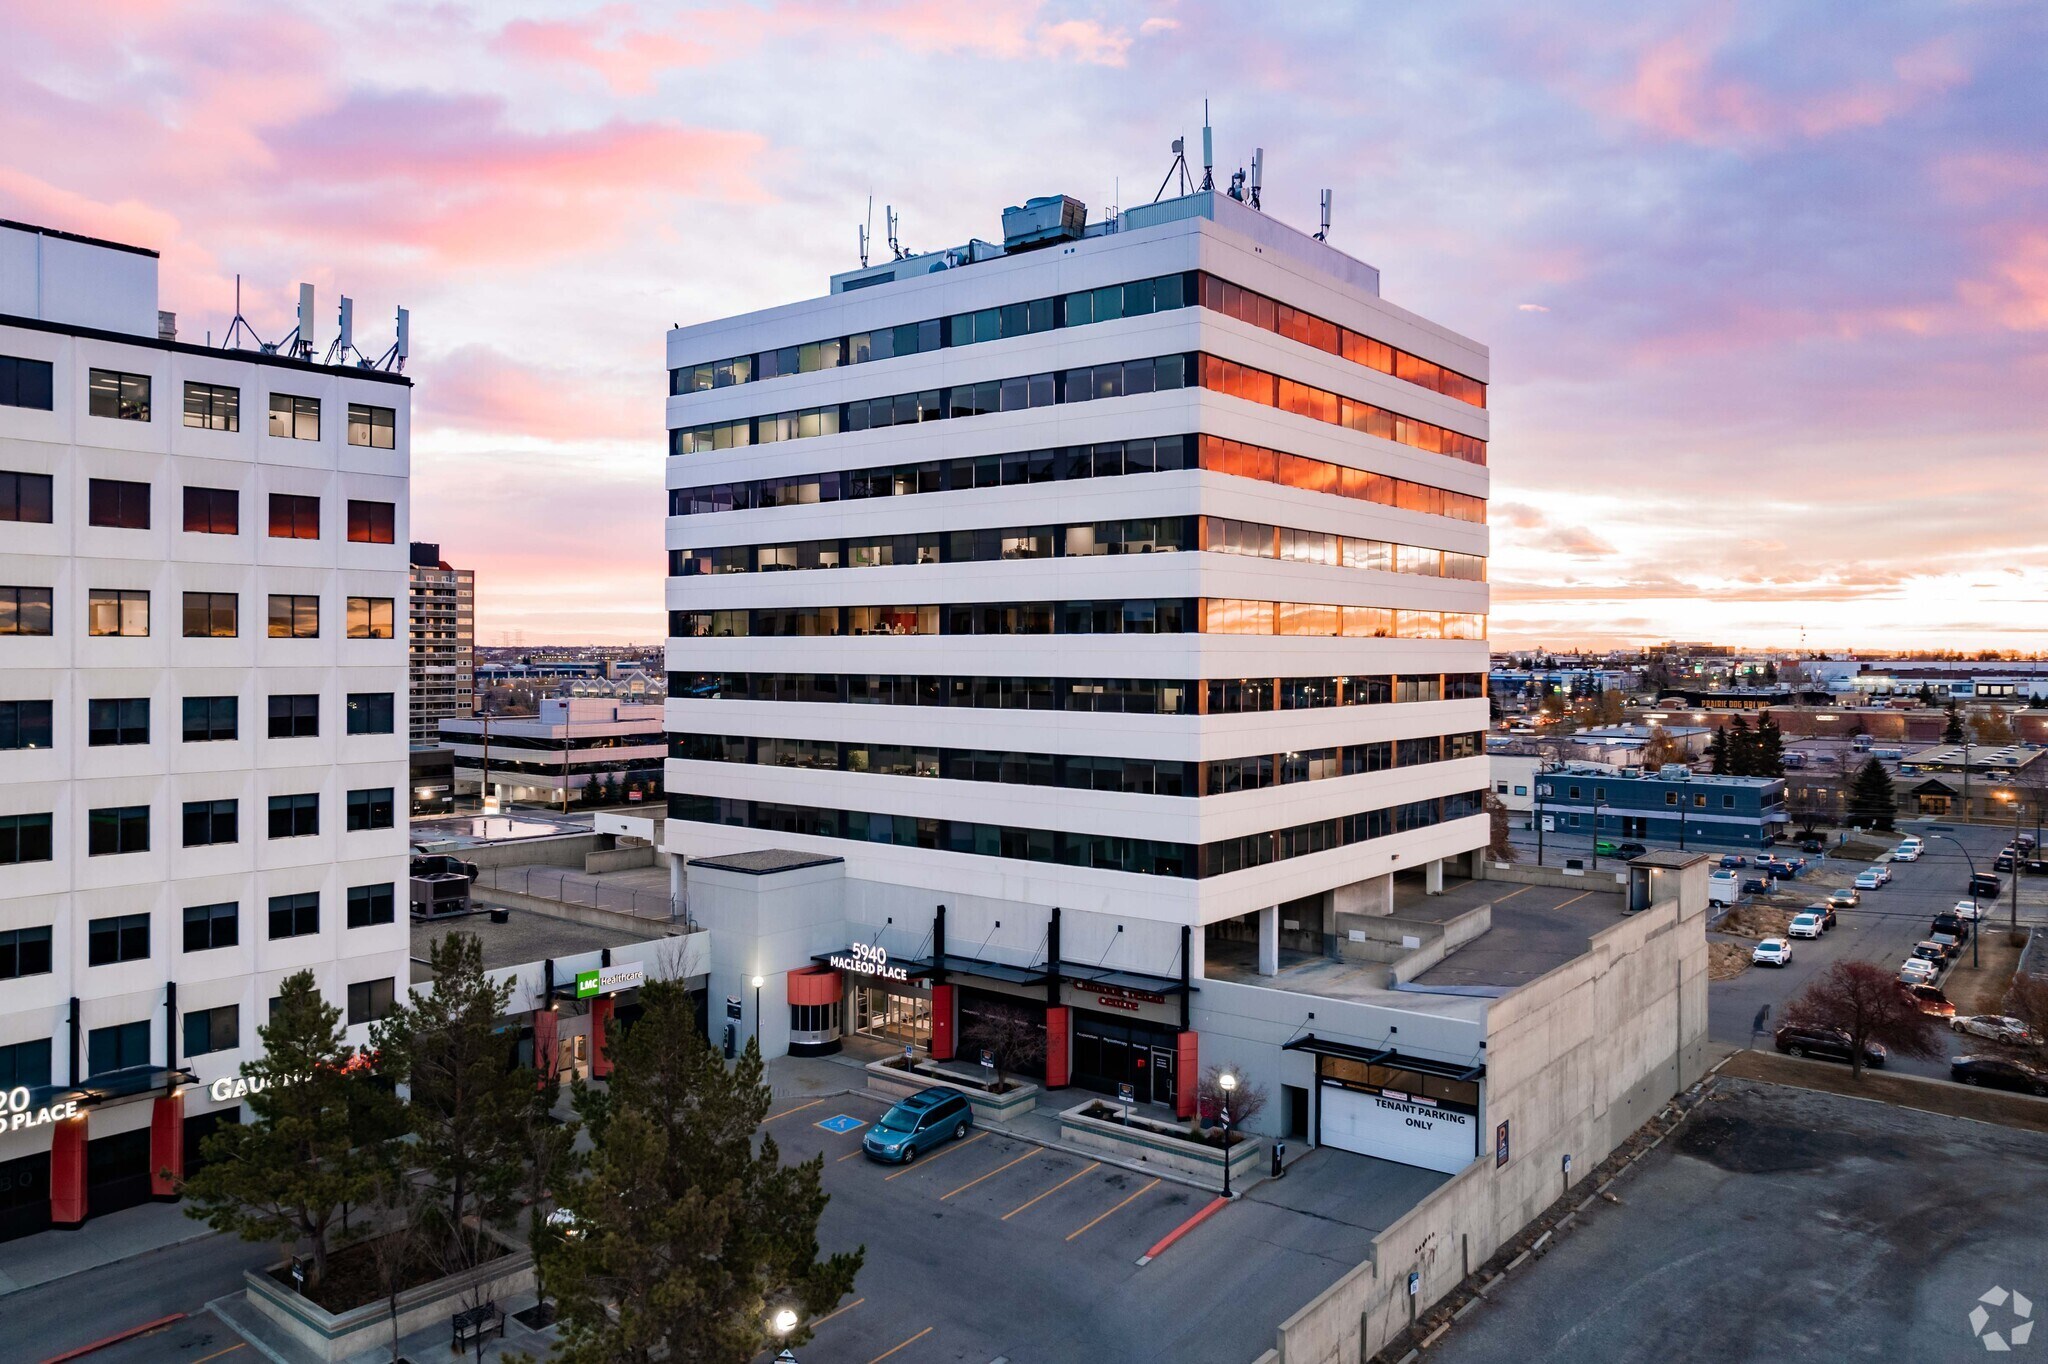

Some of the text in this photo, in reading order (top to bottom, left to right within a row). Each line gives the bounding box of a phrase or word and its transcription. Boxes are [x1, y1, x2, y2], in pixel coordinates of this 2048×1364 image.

[1729, 700, 1742, 708] DOG
[1743, 700, 1771, 709] BREWI
[852, 942, 887, 965] 5940
[830, 955, 907, 981] MACLEOD PLACE
[579, 971, 643, 991] LMC Healthcare
[11, 1100, 78, 1131] PLACE
[1375, 1098, 1416, 1114] TENANT
[1418, 1107, 1466, 1125] PARKING
[1405, 1117, 1433, 1131] ONLY
